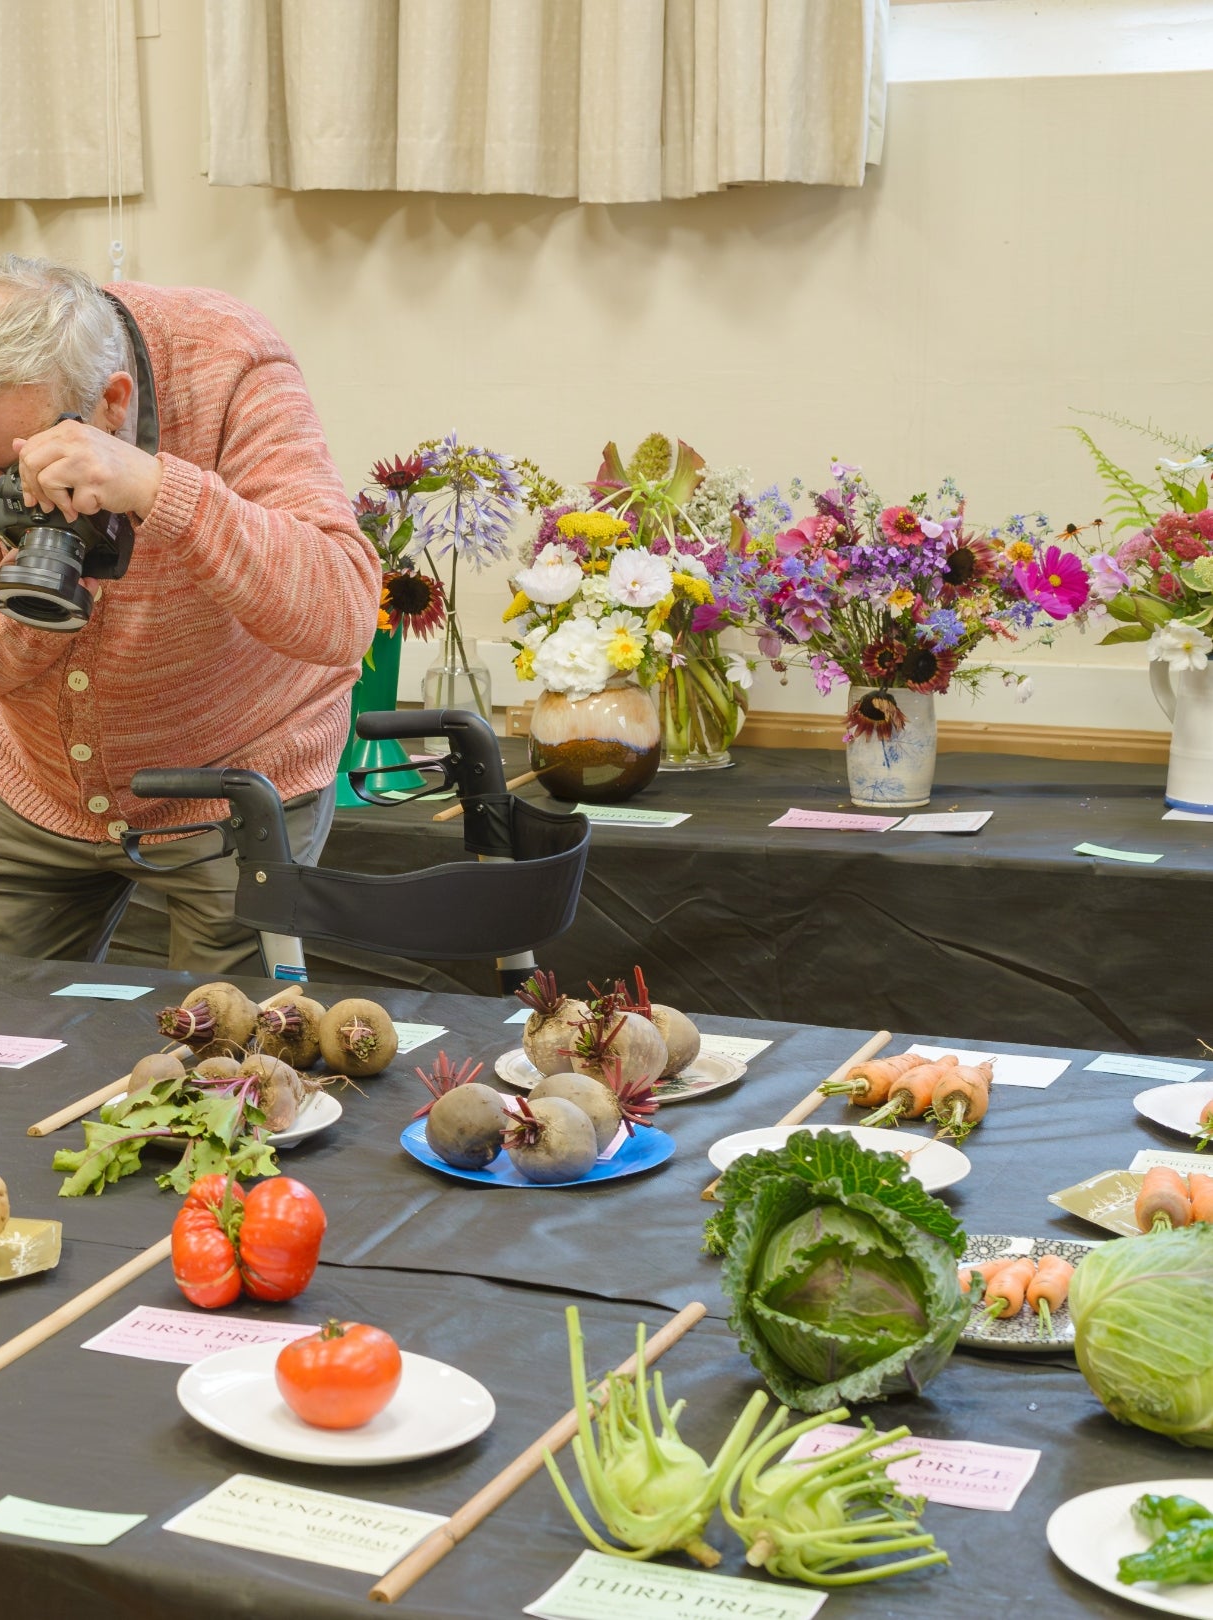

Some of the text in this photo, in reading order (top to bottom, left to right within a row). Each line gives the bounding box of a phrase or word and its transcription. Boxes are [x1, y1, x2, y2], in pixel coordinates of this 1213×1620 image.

[130, 1319, 211, 1337] FIRST
[214, 1330, 287, 1344] PRIZ
[915, 1458, 1014, 1481] PRIZE
[906, 1473, 1009, 1493] WHITEHALL
[222, 1488, 334, 1519] SECOND
[337, 1512, 417, 1537] PRIZE
[305, 1523, 400, 1551] WHITEHALL
[574, 1575, 684, 1603] THIRD
[694, 1595, 802, 1620] PRIZE
